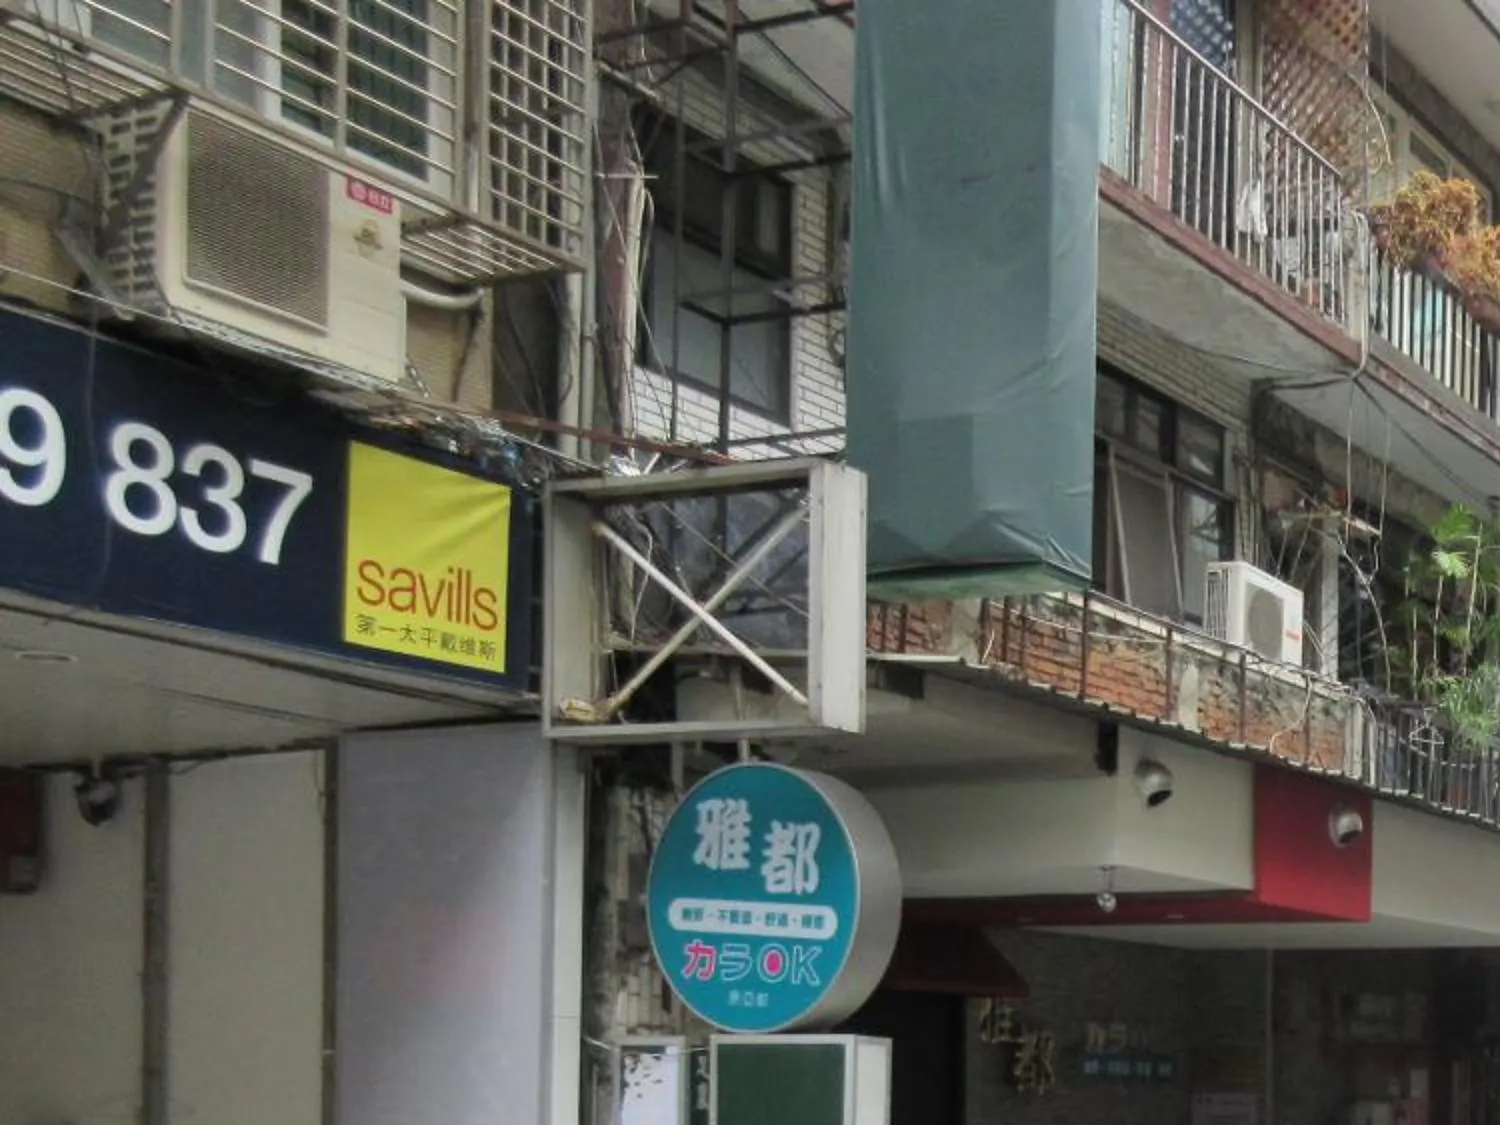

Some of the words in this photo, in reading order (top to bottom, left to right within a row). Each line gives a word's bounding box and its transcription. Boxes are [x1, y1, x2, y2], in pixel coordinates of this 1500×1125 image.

[0, 388, 66, 506] 9
[106, 422, 313, 565] 837
[356, 559, 498, 632] savills
[693, 797, 821, 895] 雅都
